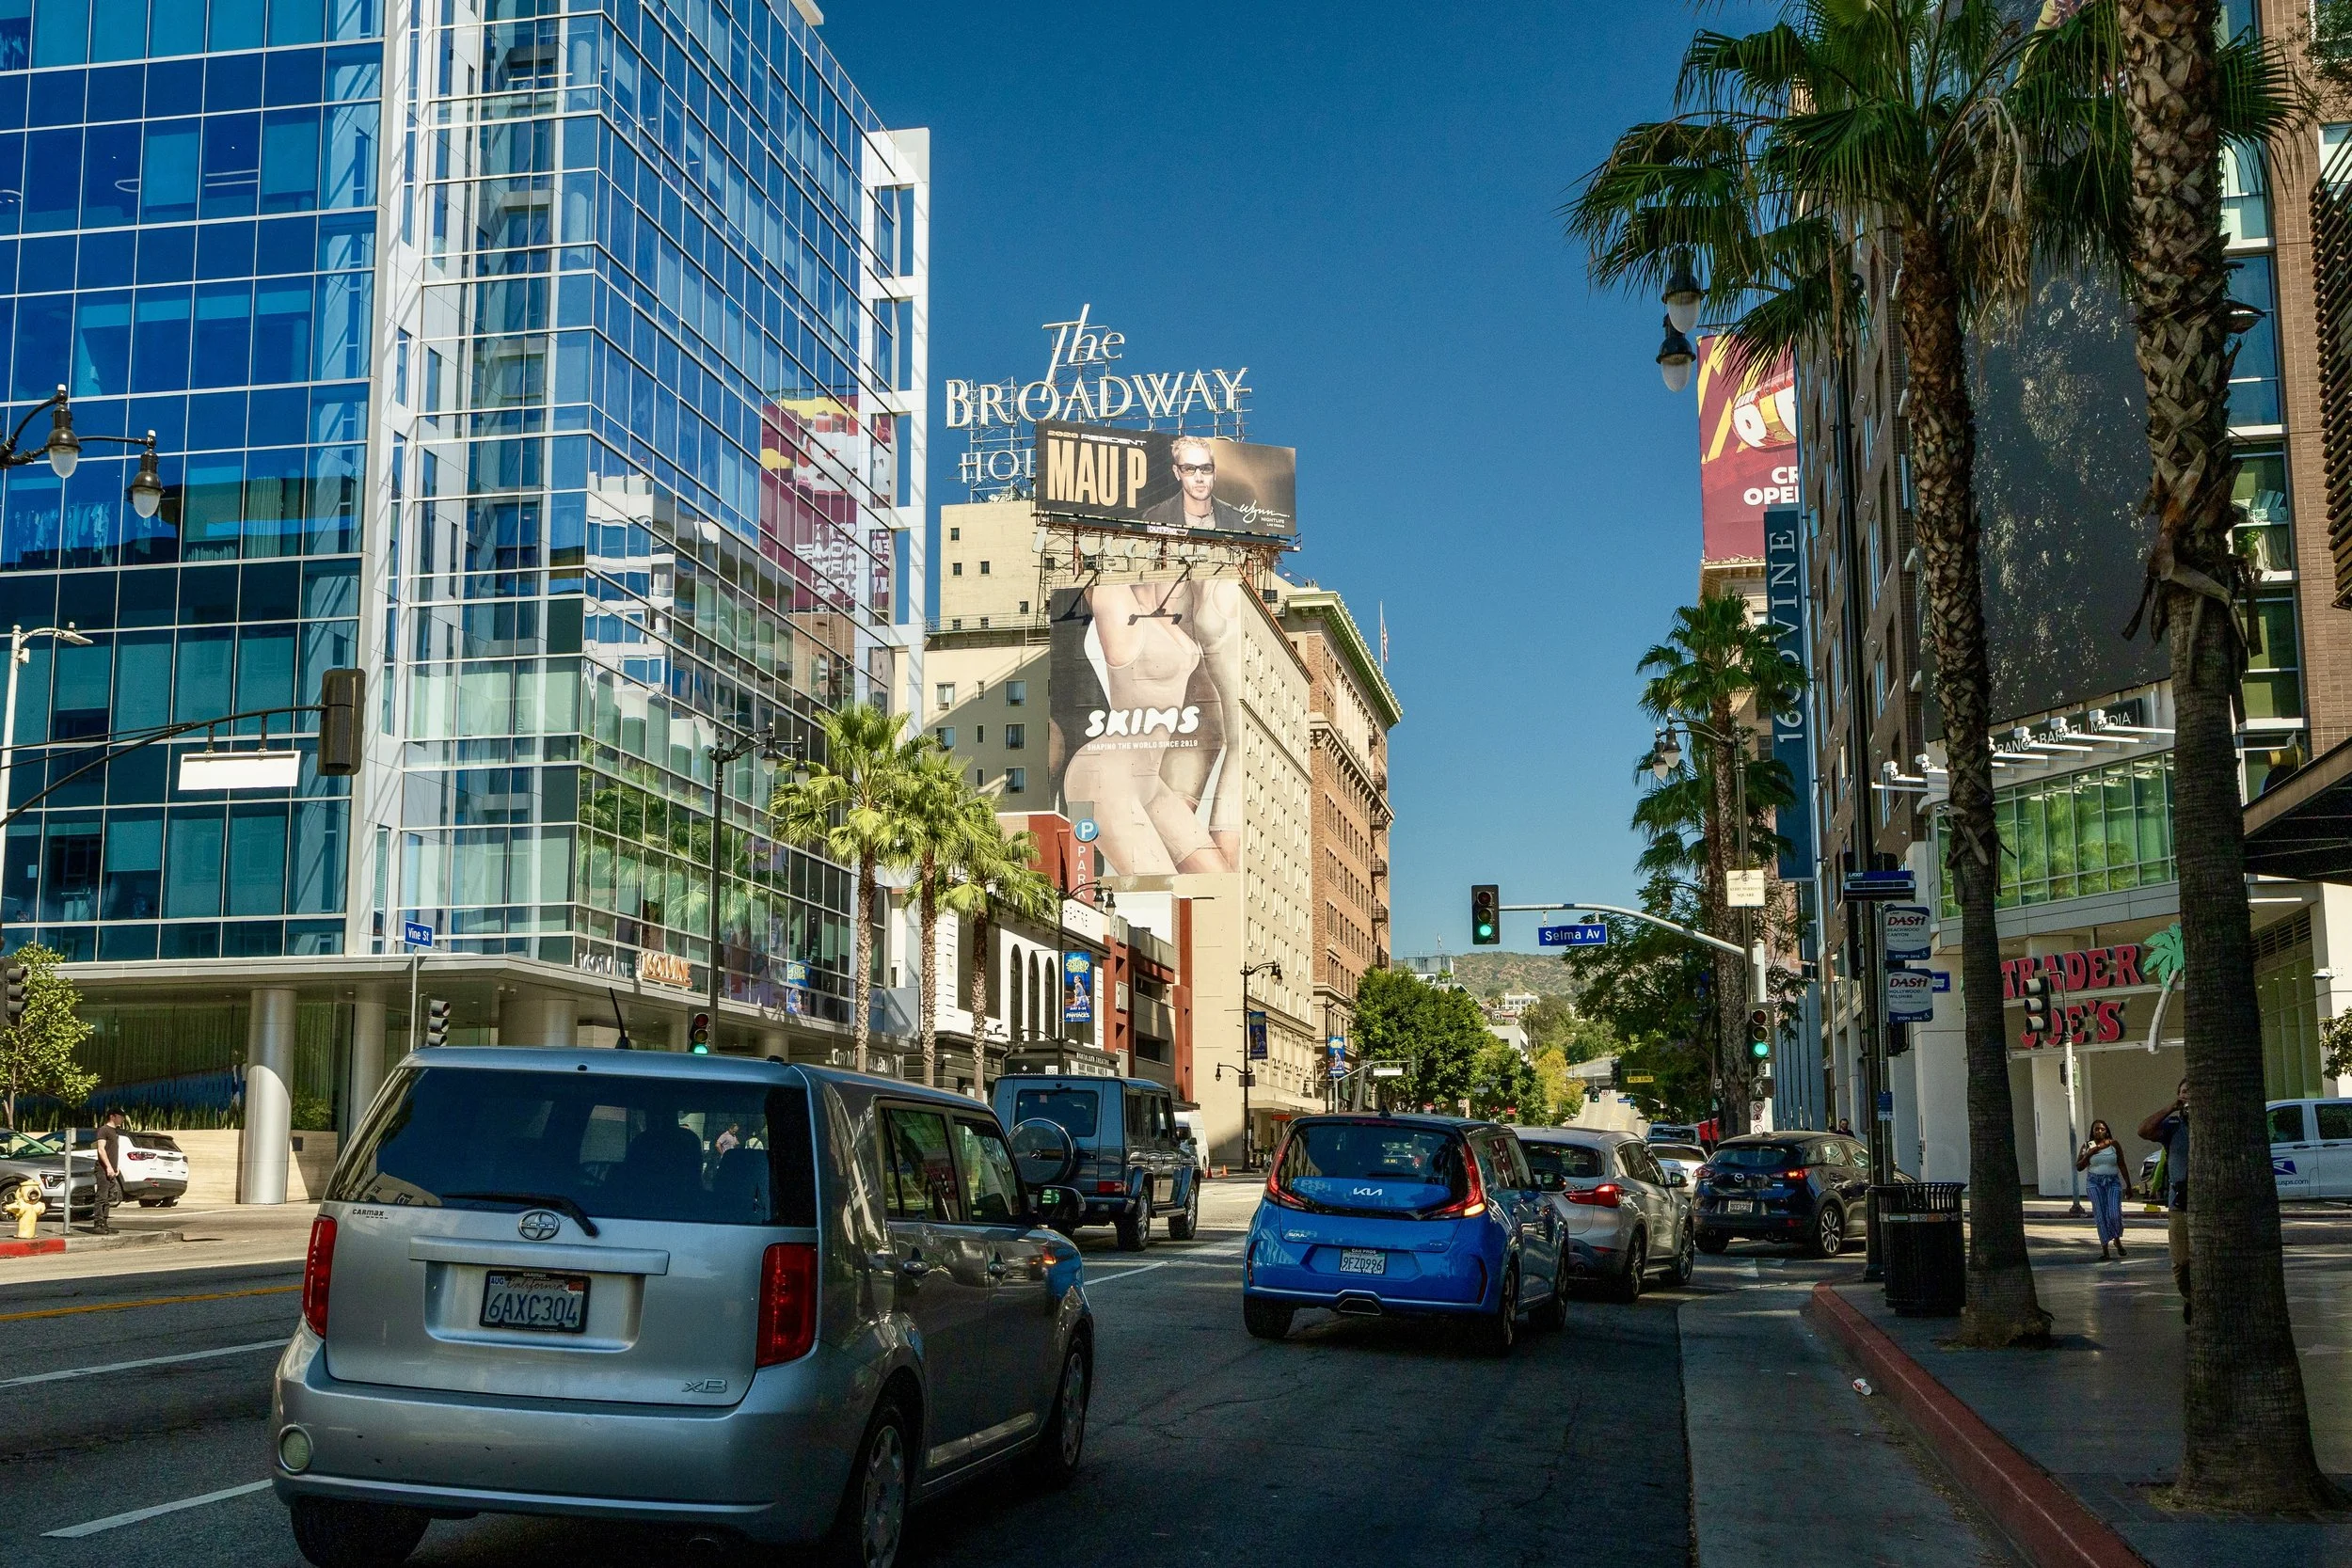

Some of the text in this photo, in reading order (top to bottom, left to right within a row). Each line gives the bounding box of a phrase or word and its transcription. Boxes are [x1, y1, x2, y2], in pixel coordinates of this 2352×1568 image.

[1041, 304, 1125, 402] The
[946, 368, 1252, 429] BROADWAY
[1081, 434, 1147, 446] RESIDENT
[1048, 438, 1148, 509] MAU P
[1085, 705, 1200, 737] SKIMS
[1087, 742, 1117, 751] SHAPING
[1081, 821, 1094, 839] P
[1887, 916, 1927, 926] DASH
[407, 927, 430, 942] Vine St
[1545, 928, 1600, 941] Selma Av
[2000, 943, 2142, 999] TRADER
[1889, 978, 1929, 987] DASH
[1353, 1187, 1383, 1196] KIA
[488, 1292, 578, 1324] 6AXC304
[681, 1378, 727, 1393] xB
